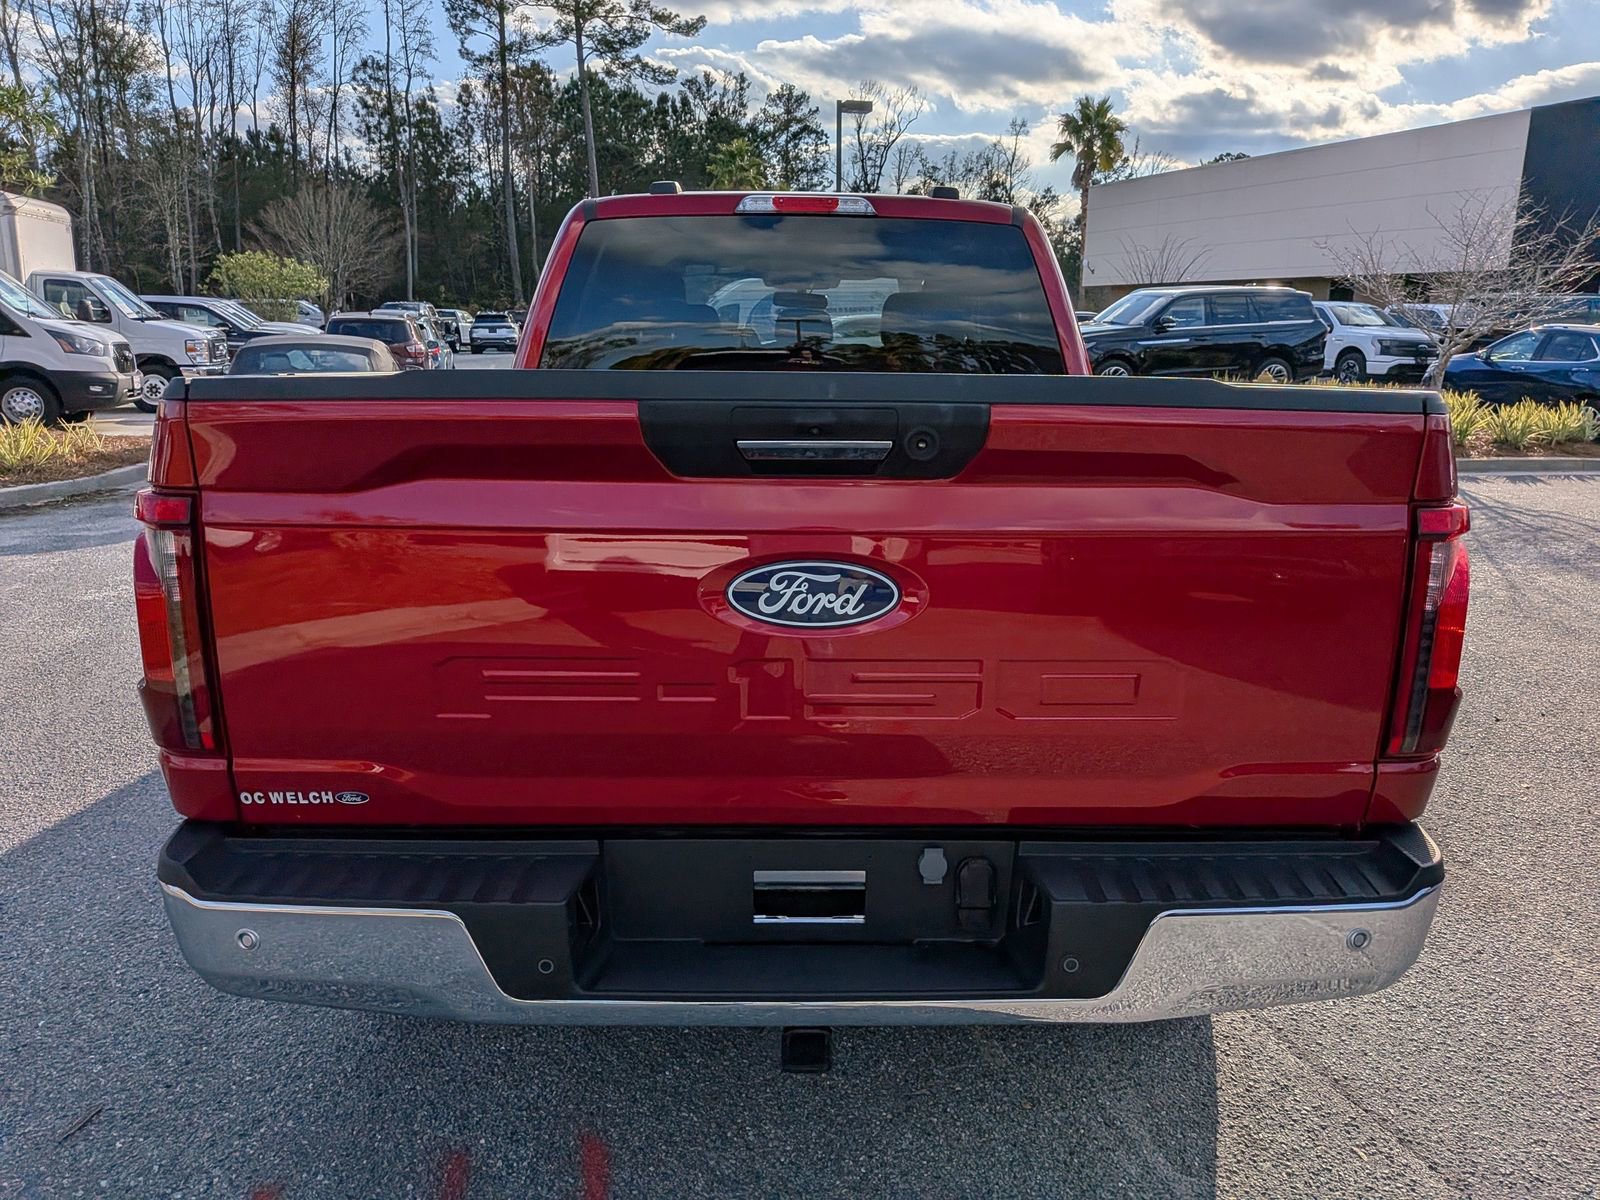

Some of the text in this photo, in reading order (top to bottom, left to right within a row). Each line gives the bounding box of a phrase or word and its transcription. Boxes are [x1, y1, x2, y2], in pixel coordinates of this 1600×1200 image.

[758, 571, 868, 615] Ford
[432, 656, 1182, 722] F-150
[240, 791, 362, 804] OC WELCH Ford
